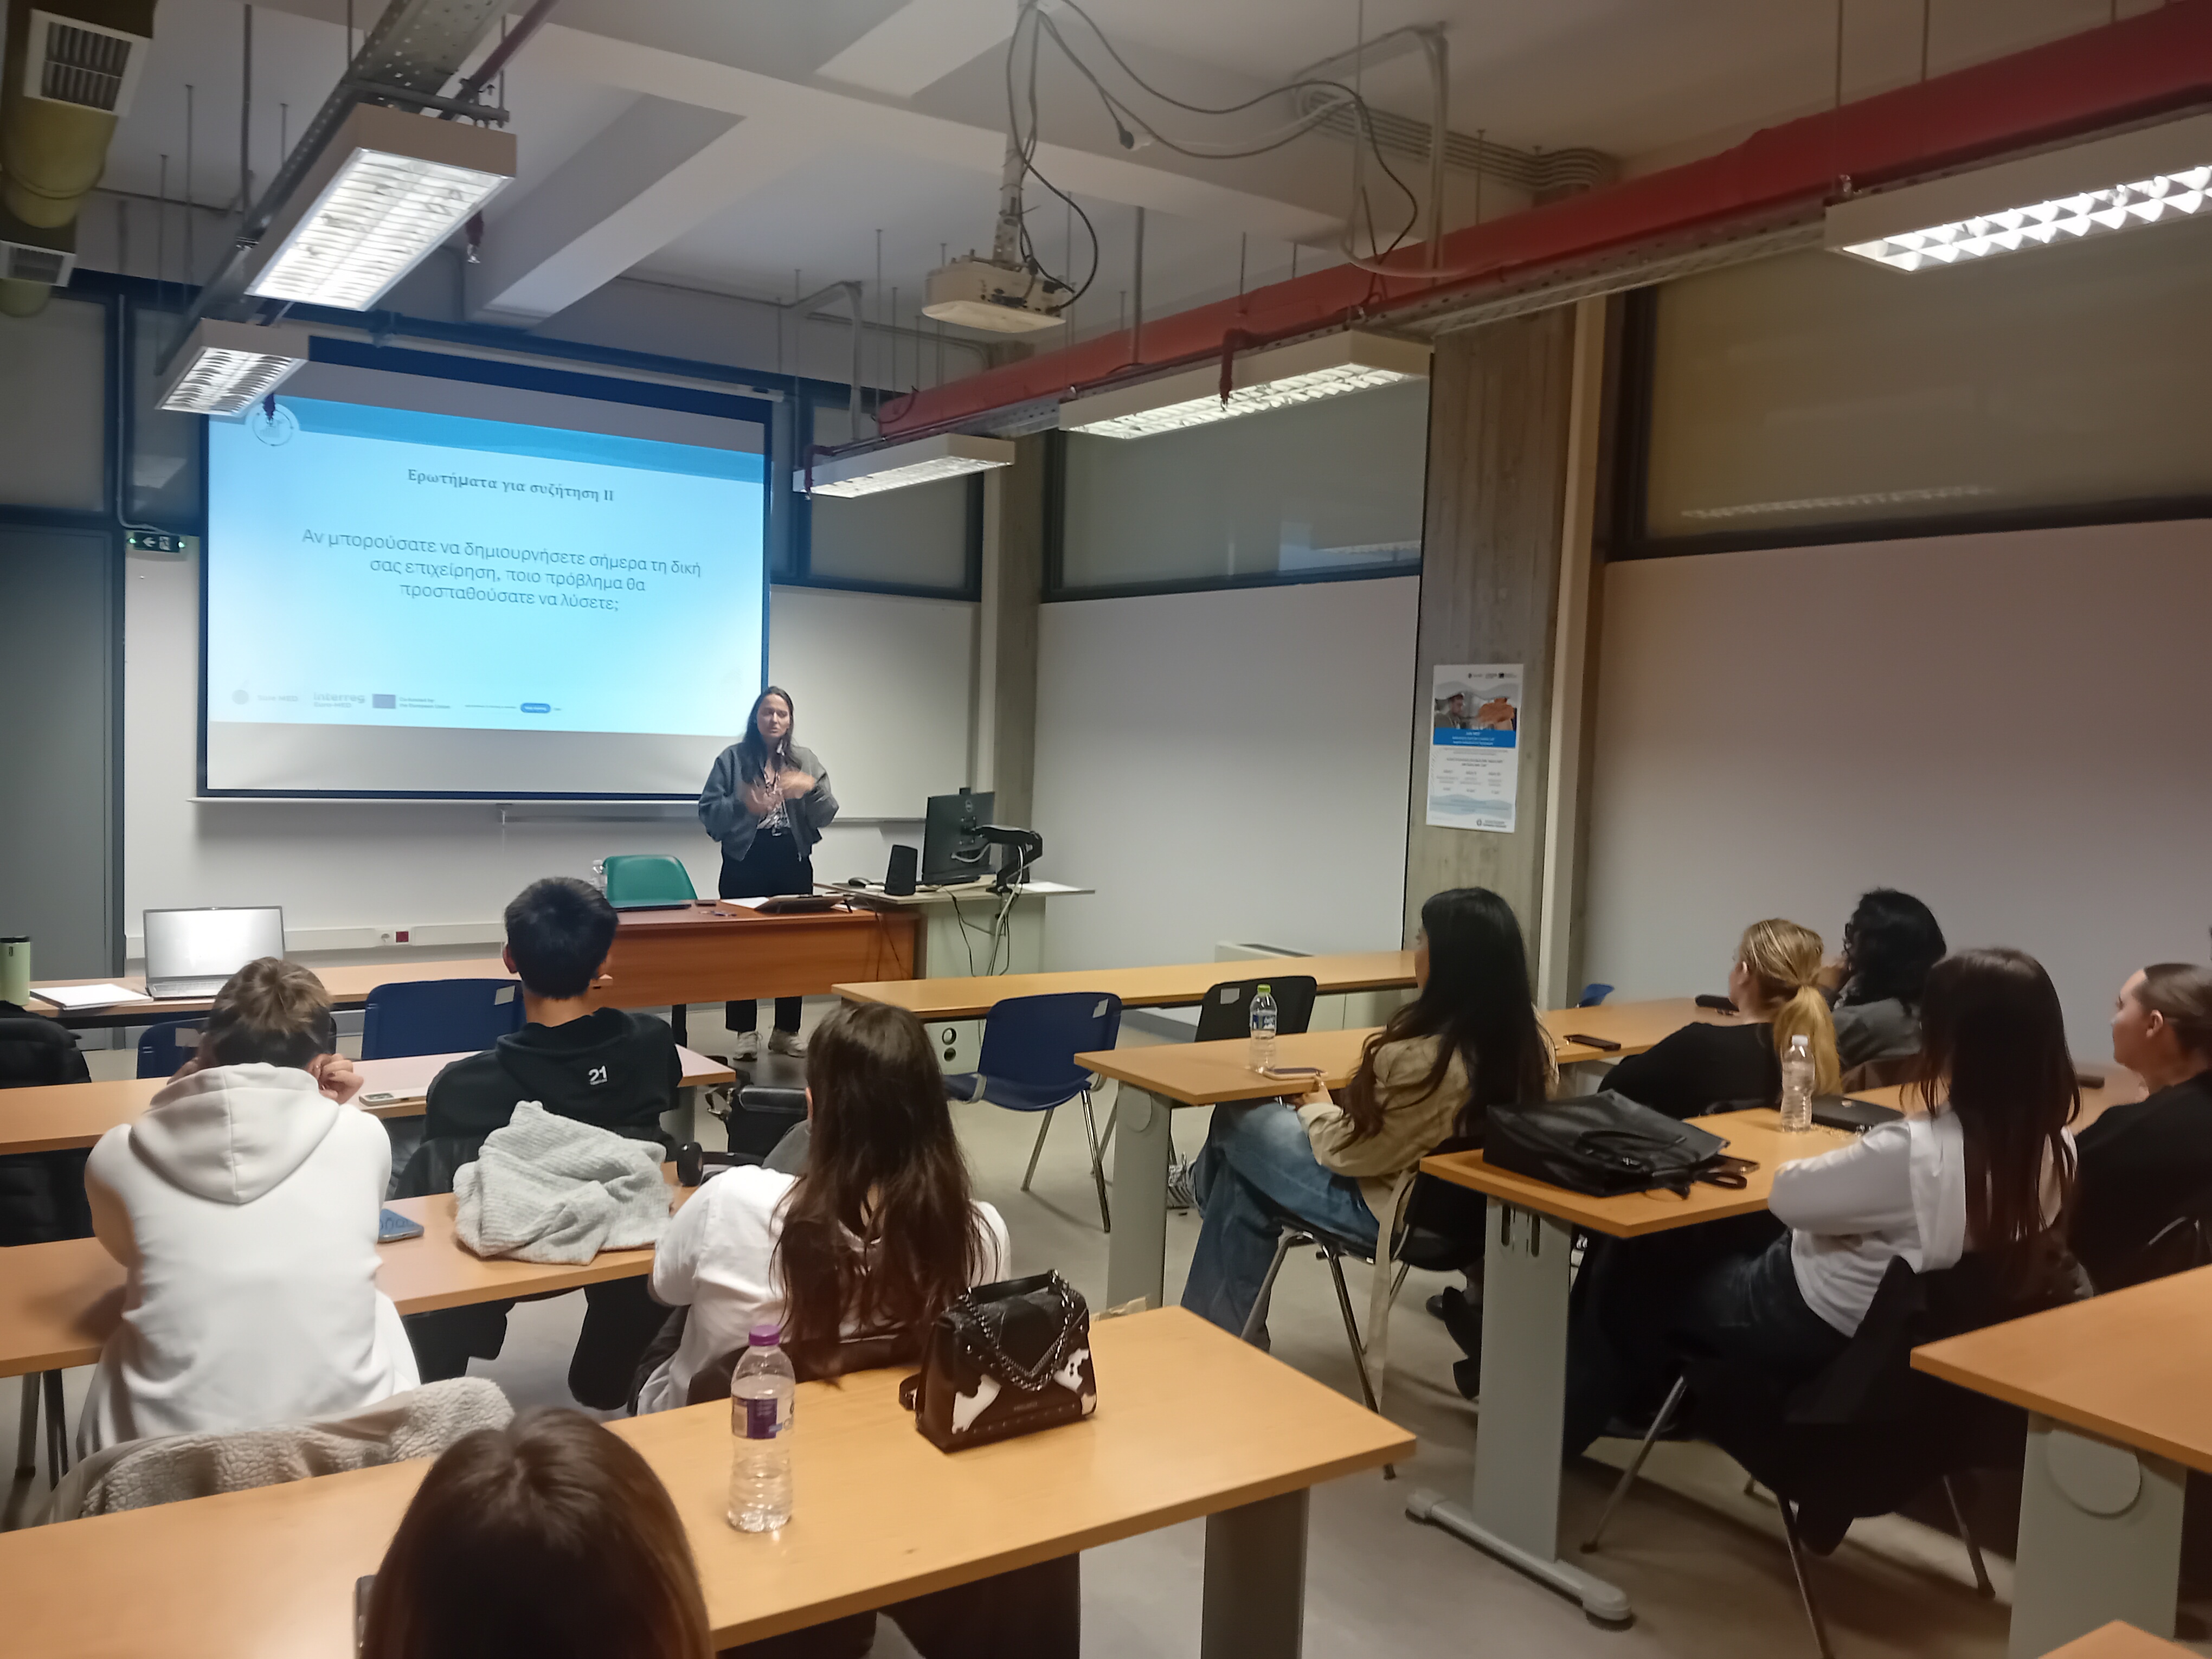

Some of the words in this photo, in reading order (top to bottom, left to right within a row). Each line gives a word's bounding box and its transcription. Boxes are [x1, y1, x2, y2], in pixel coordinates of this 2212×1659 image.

[408, 469, 498, 488] Ερωτήματα
[502, 481, 526, 493] για
[530, 483, 599, 503] συζήτηση
[301, 529, 325, 543] Αν
[329, 534, 436, 553] μπορούσατε
[440, 542, 460, 555] να
[464, 542, 586, 565] δημιουργήσετε
[589, 553, 647, 572] σήμερα
[651, 560, 667, 575] τη
[671, 560, 701, 577] δική
[370, 559, 402, 575] σας
[405, 562, 501, 583] επιχείρηση,
[505, 569, 542, 583] ποιο
[545, 571, 623, 590] πρόβλημα
[627, 577, 646, 591] θα
[399, 584, 536, 605] προσπαθούσατε
[538, 594, 557, 606] να
[560, 593, 619, 612] λύσετε;
[588, 1065, 607, 1082] 21
